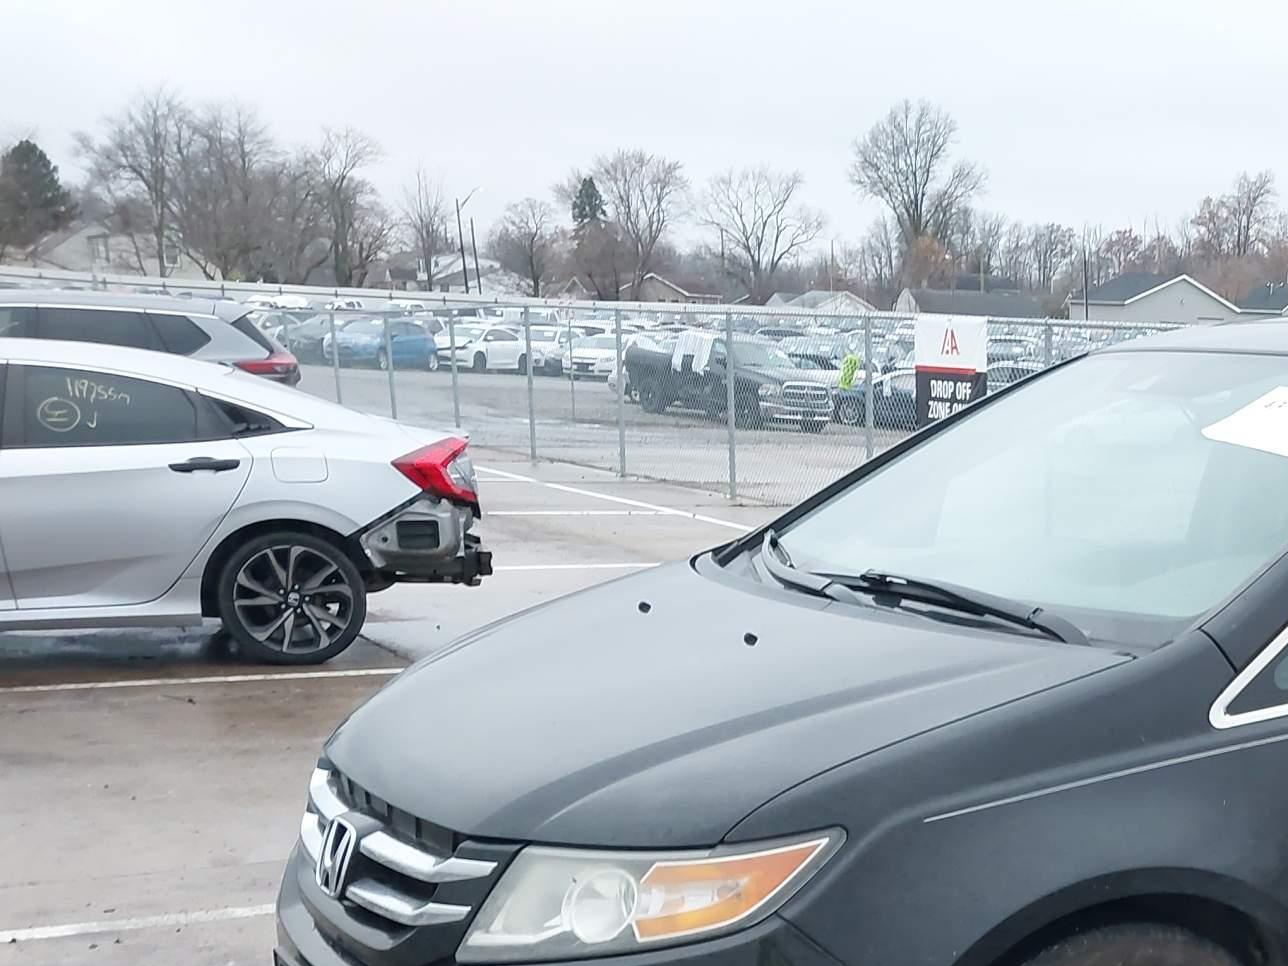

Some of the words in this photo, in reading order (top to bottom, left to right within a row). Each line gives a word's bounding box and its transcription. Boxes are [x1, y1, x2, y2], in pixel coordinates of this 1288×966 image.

[930, 379, 954, 399] DROP
[955, 381, 972, 400] OFF
[928, 400, 951, 418] ZONE
